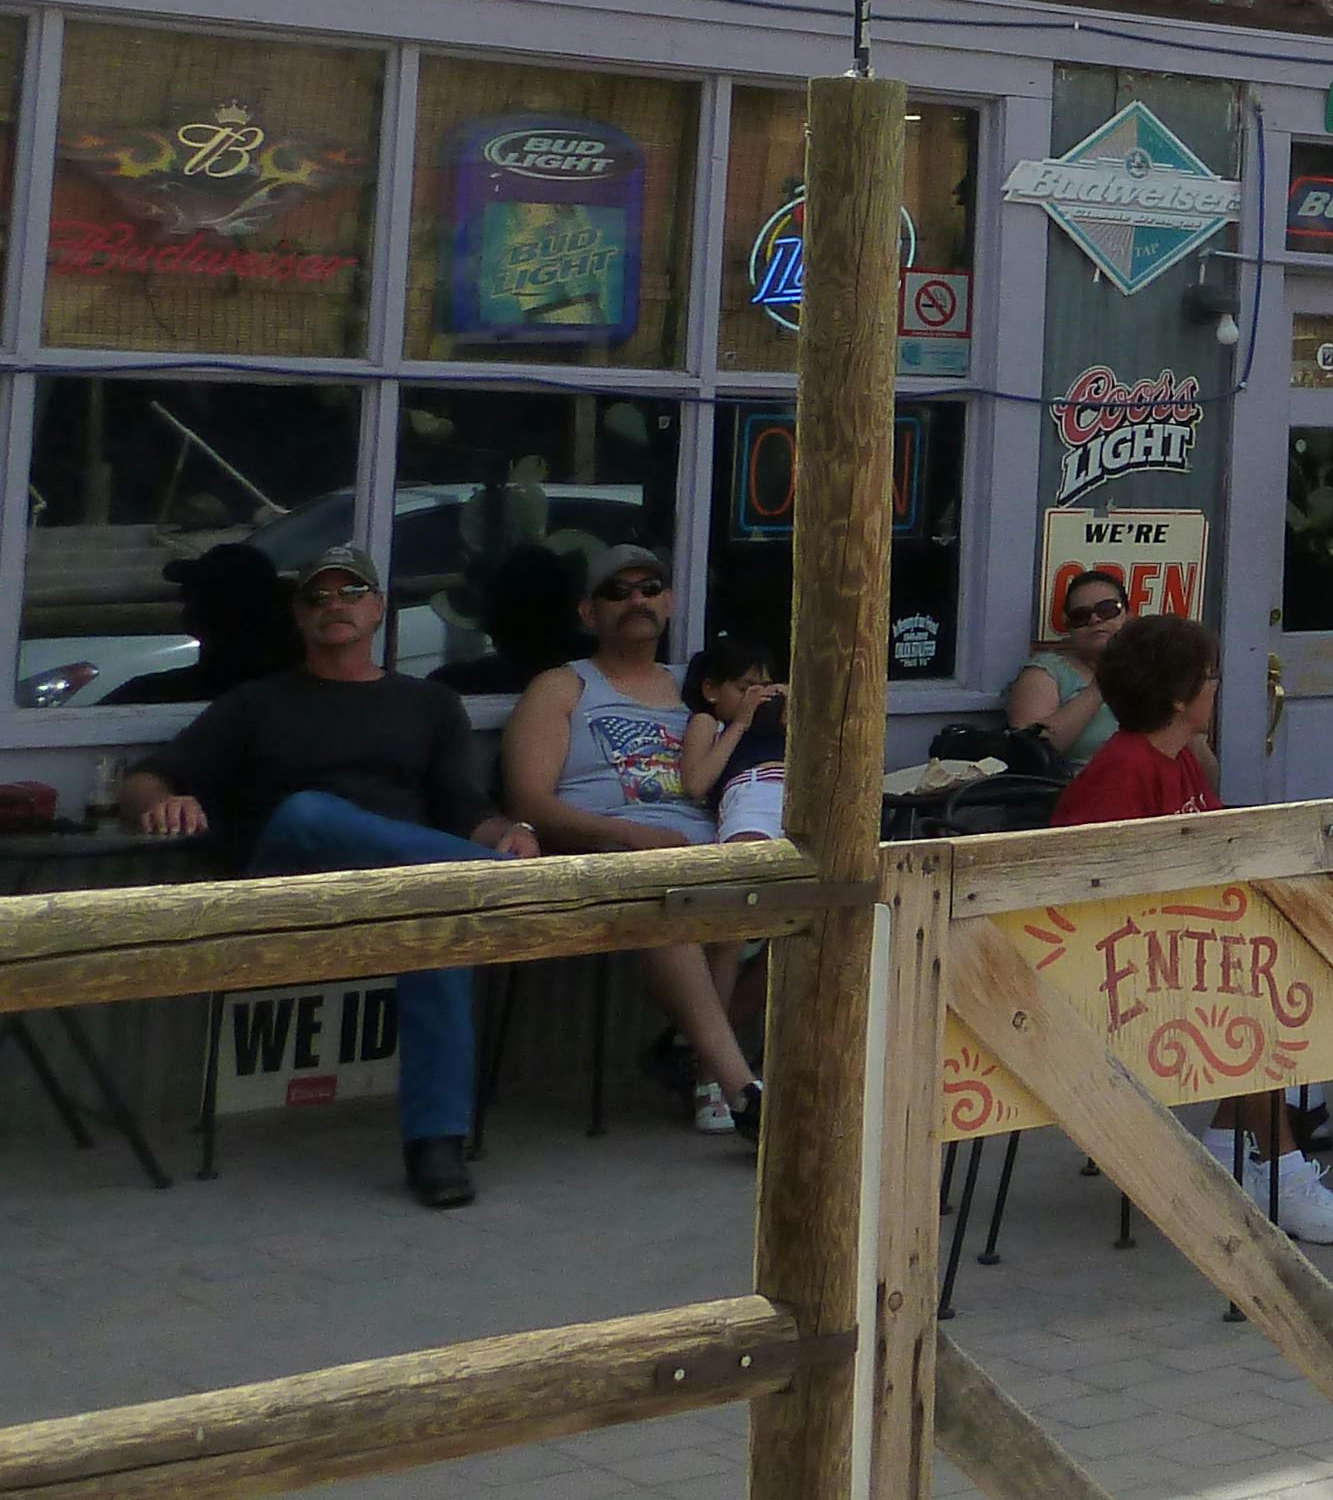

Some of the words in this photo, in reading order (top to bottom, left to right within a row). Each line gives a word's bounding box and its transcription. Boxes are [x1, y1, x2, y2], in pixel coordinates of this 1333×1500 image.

[502, 152, 615, 173] LIGHT
[523, 137, 607, 155] BUD
[1025, 167, 1229, 214] Budweiser
[50, 218, 359, 283] Budweiser
[491, 246, 618, 298] LIGHT
[508, 227, 601, 268] BUD
[1135, 243, 1160, 258] TAP
[1052, 367, 1203, 446] Coors
[750, 426, 913, 518] ON
[1058, 421, 1191, 503] LIGHT
[1085, 523, 1171, 544] WE'RE
[1050, 562, 1199, 636] OEN
[1095, 915, 1314, 1034] ENTER
[233, 995, 325, 1077] WE
[339, 987, 399, 1065] ID
